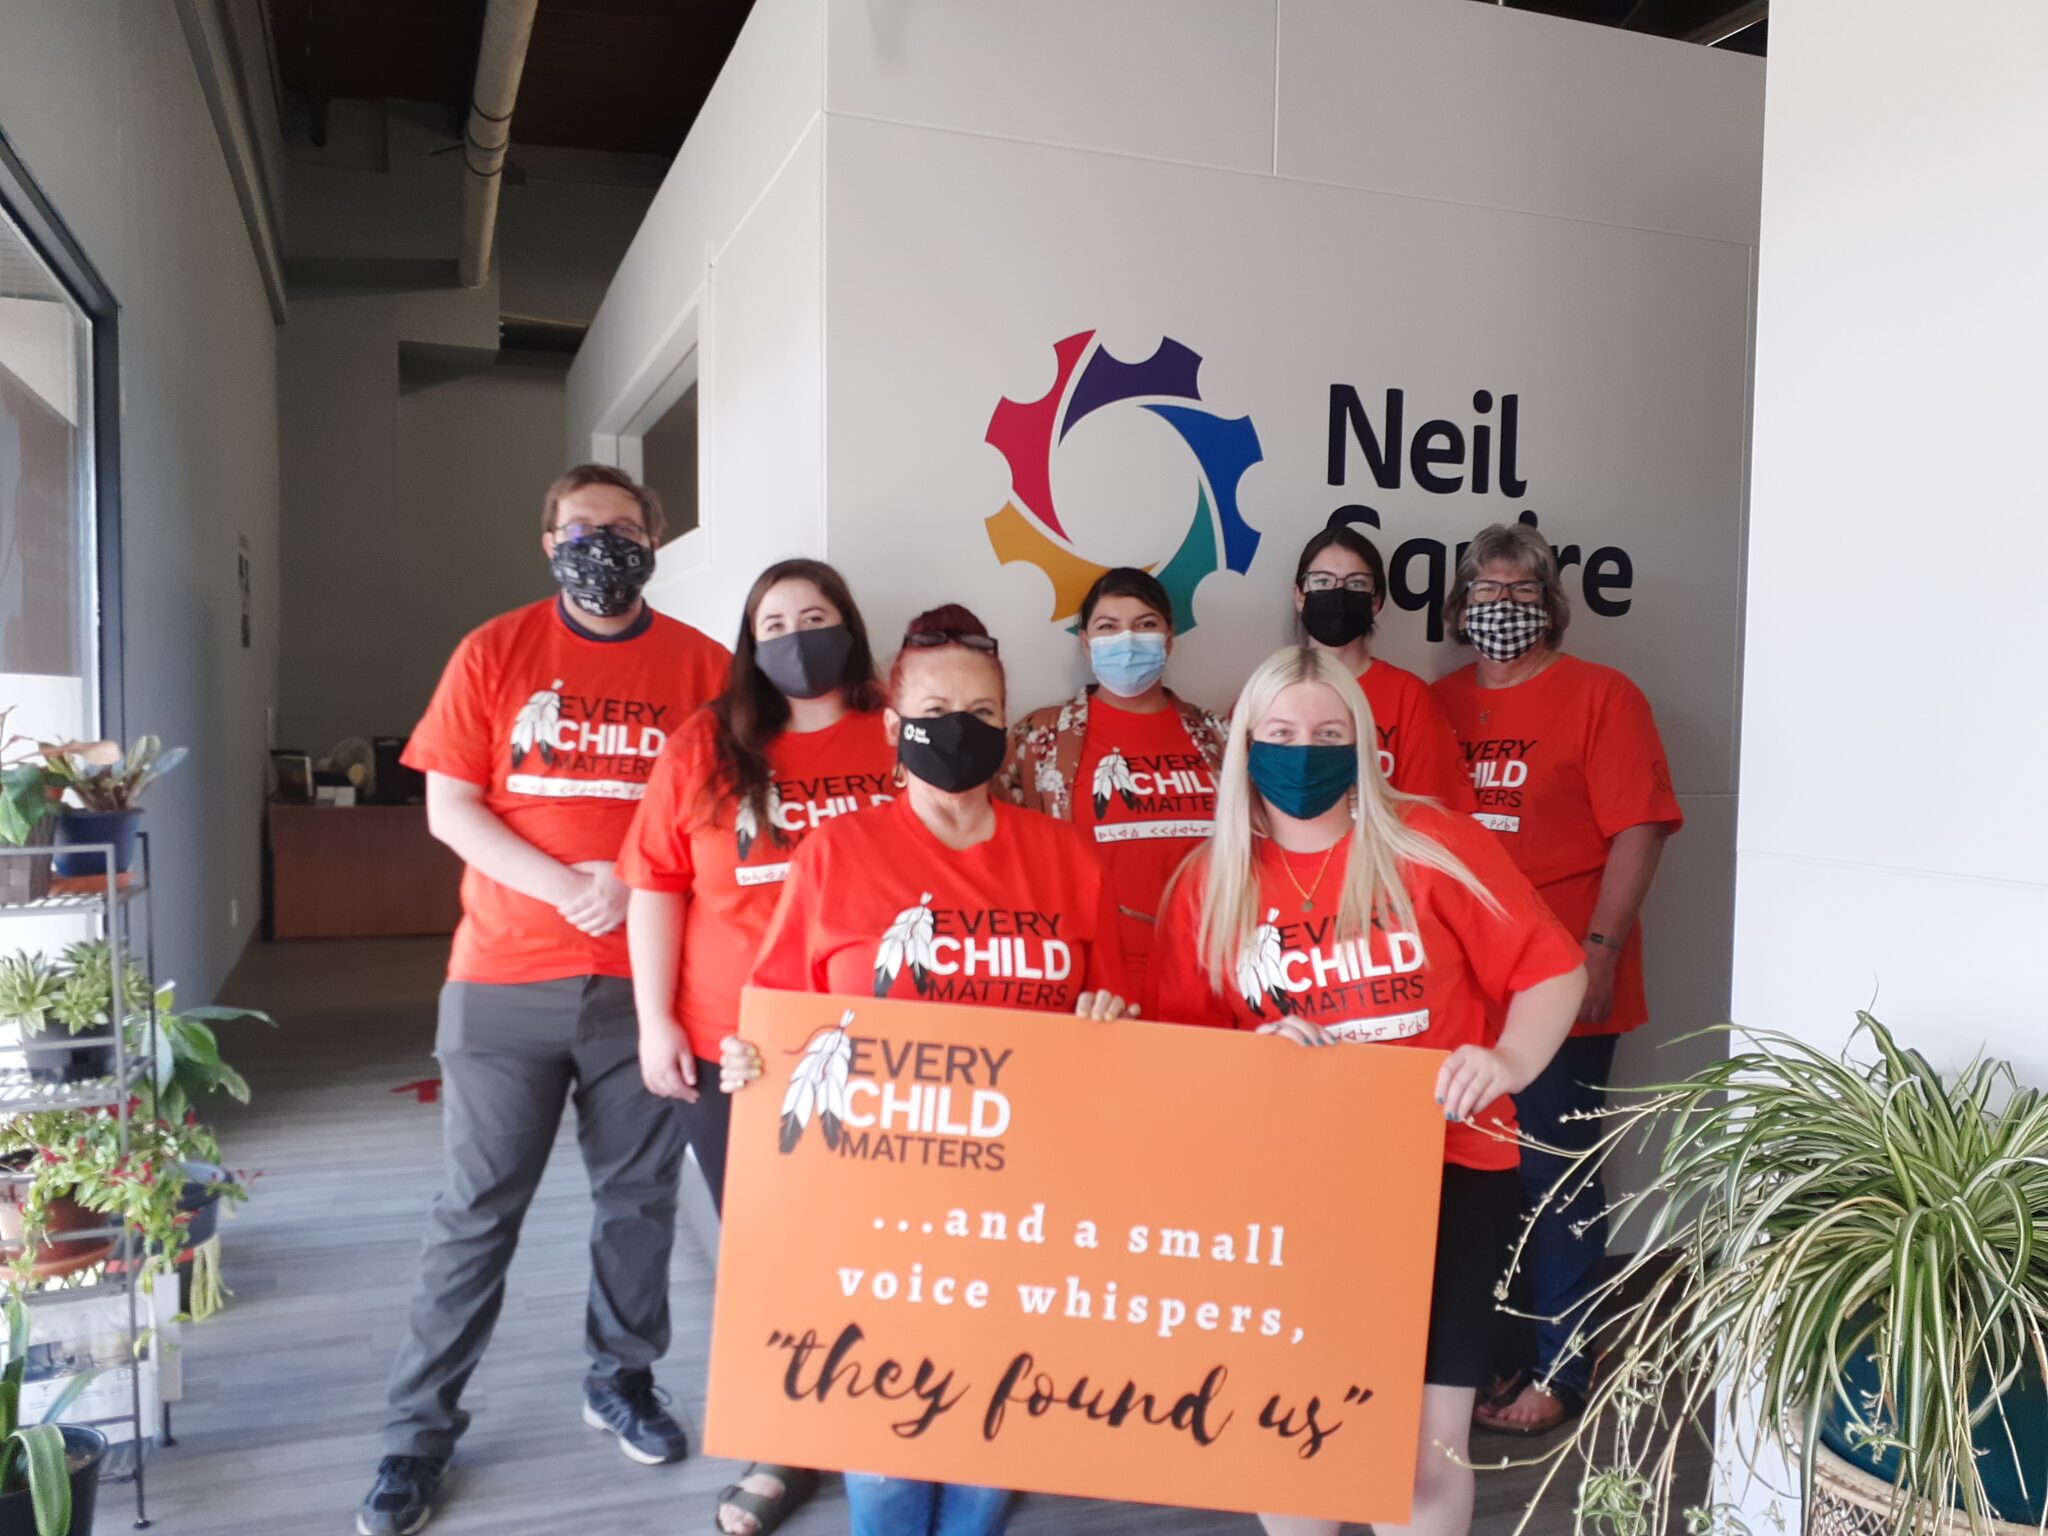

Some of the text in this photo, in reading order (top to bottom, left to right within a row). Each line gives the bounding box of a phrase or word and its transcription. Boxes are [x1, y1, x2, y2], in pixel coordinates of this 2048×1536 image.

[1327, 383, 1528, 499] Neil
[558, 694, 667, 725] EVERY
[555, 719, 667, 758] CHILD
[1459, 739, 1537, 762] VERY
[551, 752, 655, 775] MATTER
[1124, 754, 1206, 773] EVER
[1129, 770, 1218, 796] CHIL
[1469, 760, 1528, 788] HILD
[776, 773, 888, 801] EVERY
[1134, 795, 1216, 813] MATTE
[932, 909, 1062, 937] EVERY
[930, 936, 1072, 981] CHILD
[1281, 931, 1426, 993] CHILD
[927, 978, 1069, 1007] MATTERS
[1289, 974, 1424, 1018] MATTERS
[849, 1036, 1013, 1087] EVERY
[843, 1078, 1011, 1138] CHILD
[840, 1130, 1006, 1172] MATTERS
[873, 1203, 1285, 1267] ...and a small
[837, 1263, 1304, 1345] voice whispers,
[982, 1353, 1234, 1447] found
